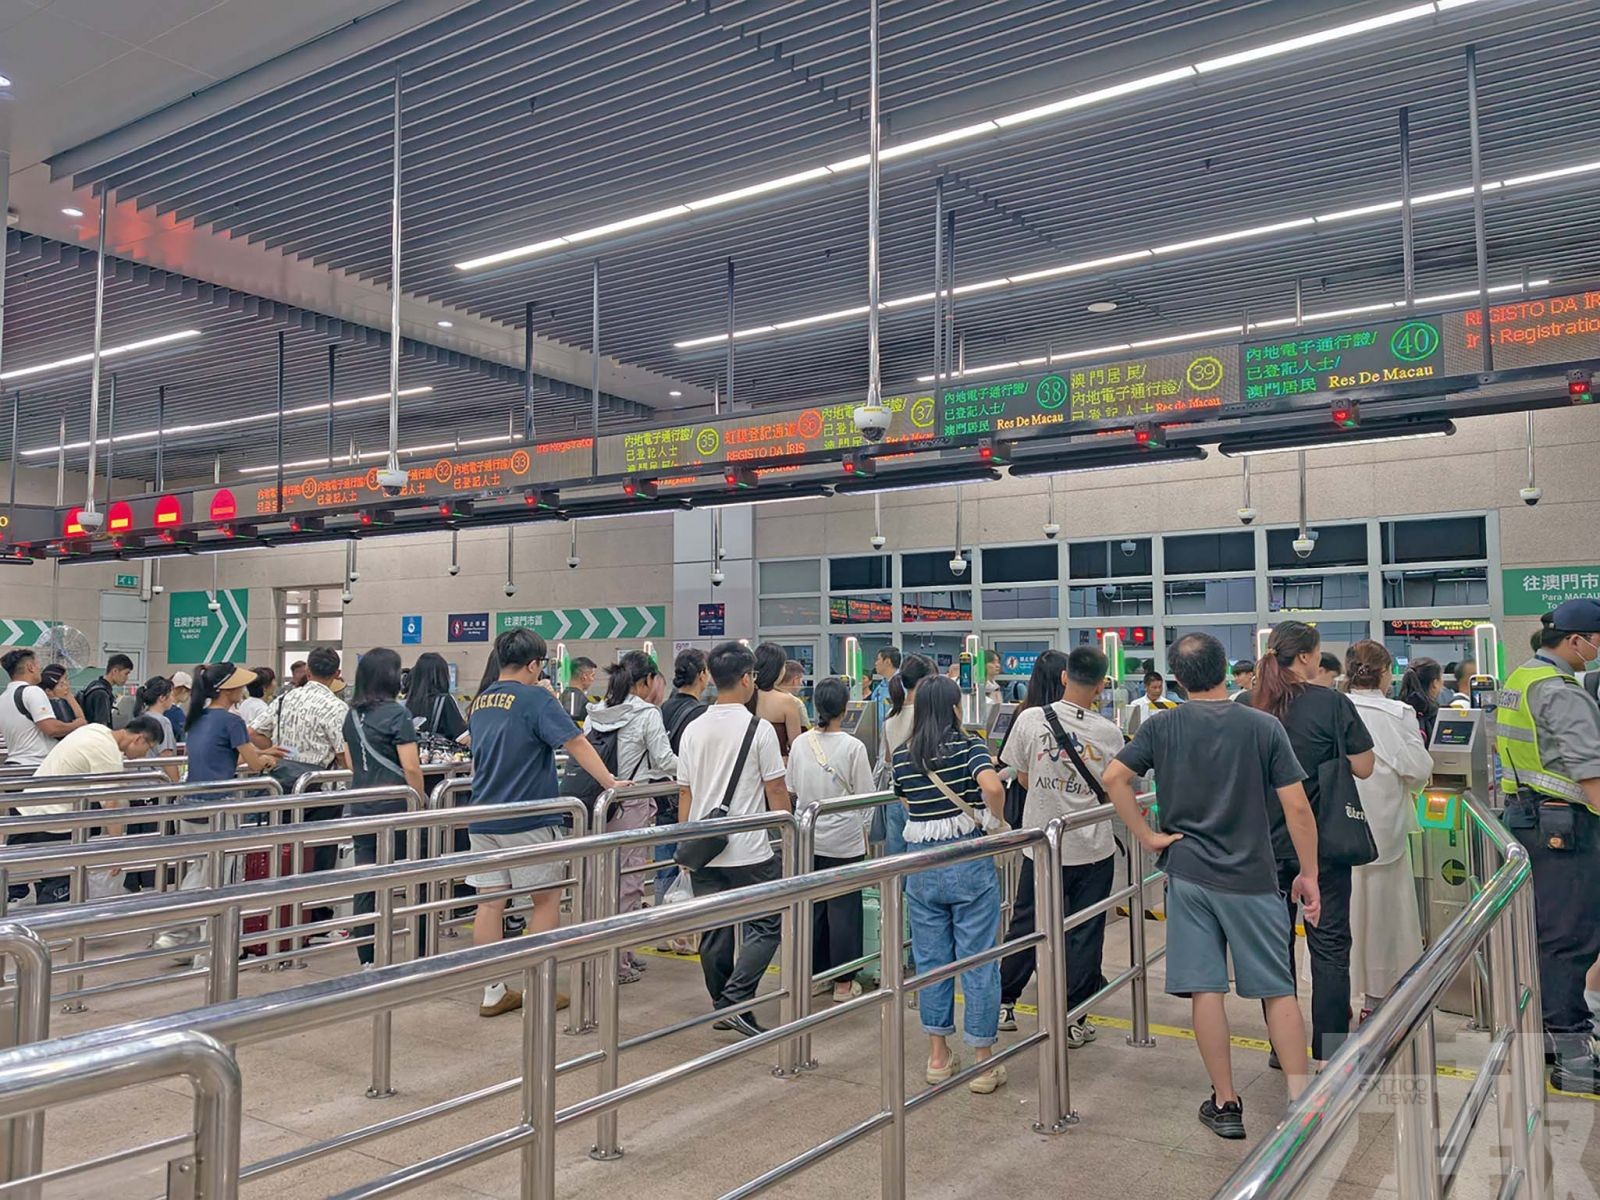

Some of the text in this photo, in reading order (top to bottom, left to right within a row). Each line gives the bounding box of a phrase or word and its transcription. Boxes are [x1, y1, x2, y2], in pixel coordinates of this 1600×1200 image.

[1551, 297, 1578, 315] DA
[1397, 328, 1430, 355] 40
[1193, 363, 1216, 382] 39
[1328, 365, 1434, 389] Res De Macau
[1041, 381, 1061, 403] 38
[1246, 377, 1317, 400] 澳門居民
[916, 405, 933, 421] 37
[997, 413, 1064, 430] Res De Macau
[944, 420, 990, 436] 澳門居民
[700, 433, 715, 448] 35
[726, 447, 767, 461] REGISTO
[769, 445, 784, 456] DA
[438, 464, 449, 477] 32
[514, 455, 526, 469] 33
[1523, 572, 1600, 592] 往澳門市
[1542, 593, 1562, 601] Para
